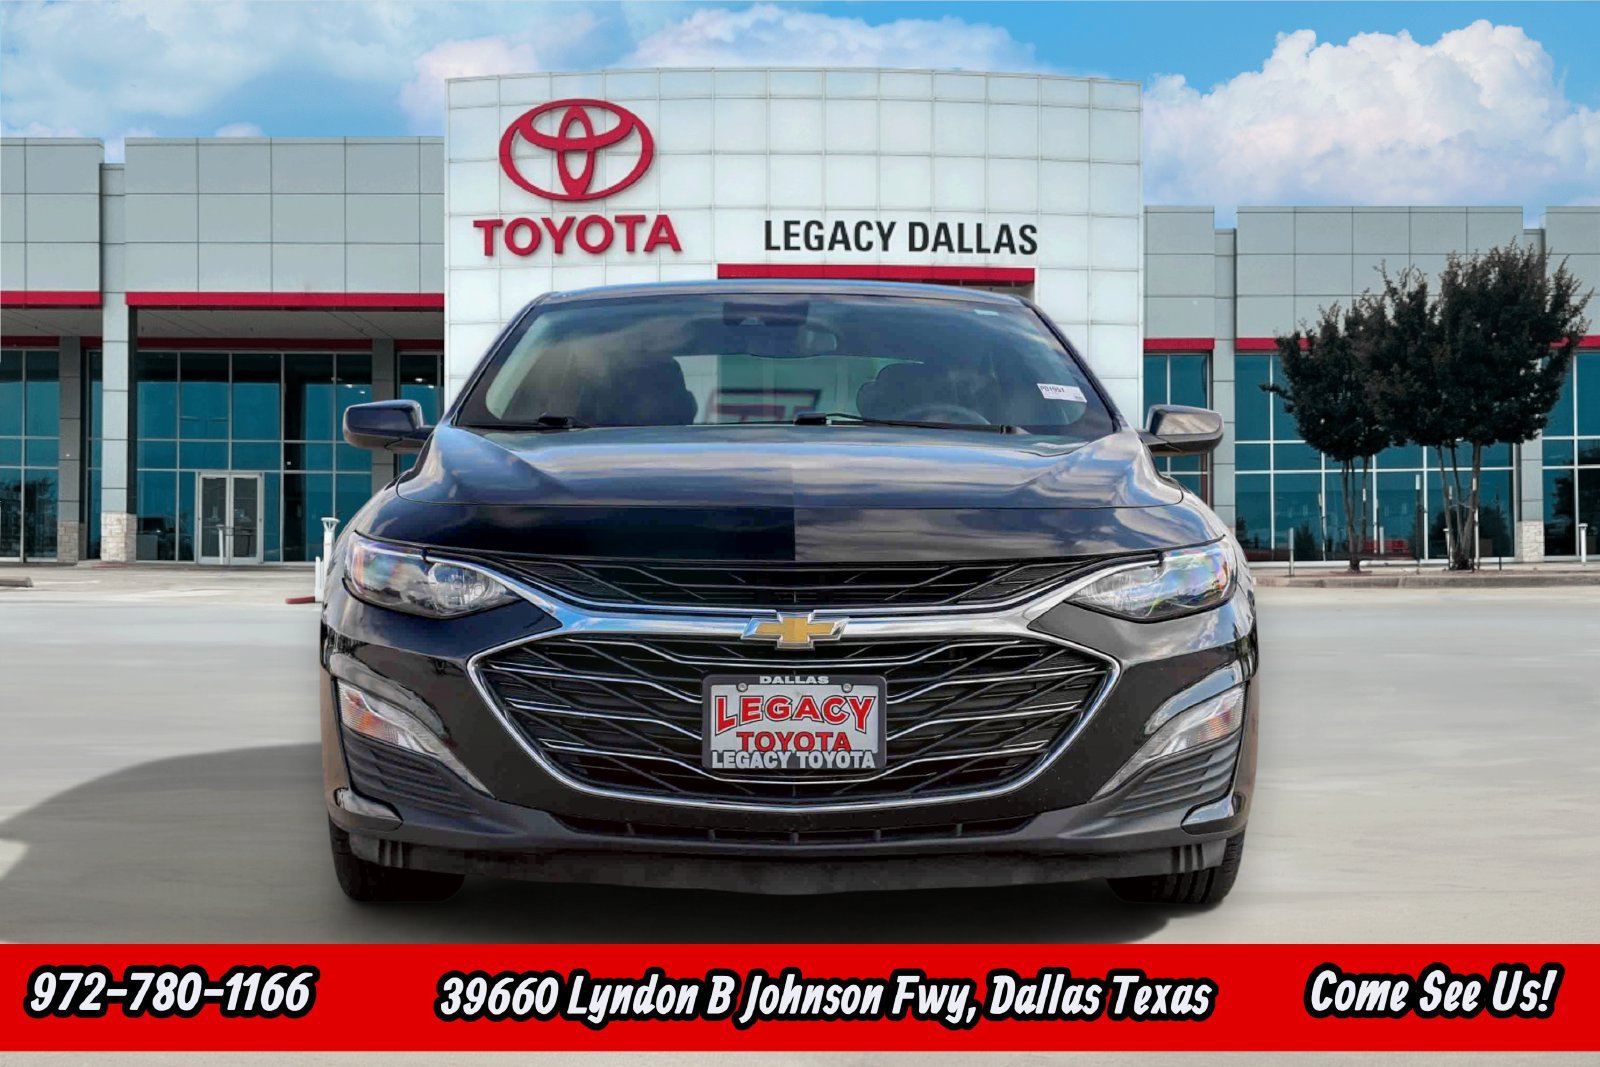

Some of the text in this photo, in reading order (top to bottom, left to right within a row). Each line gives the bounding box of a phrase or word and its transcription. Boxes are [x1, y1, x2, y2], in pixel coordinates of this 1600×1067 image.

[474, 214, 681, 256] TOYOTA
[764, 220, 1037, 255] LEGACY DALLAS
[759, 675, 830, 685] DALLAS
[715, 695, 876, 736] LEGACY
[736, 731, 852, 752] TOYOTA
[711, 750, 876, 769] LEGACY TOYOTA
